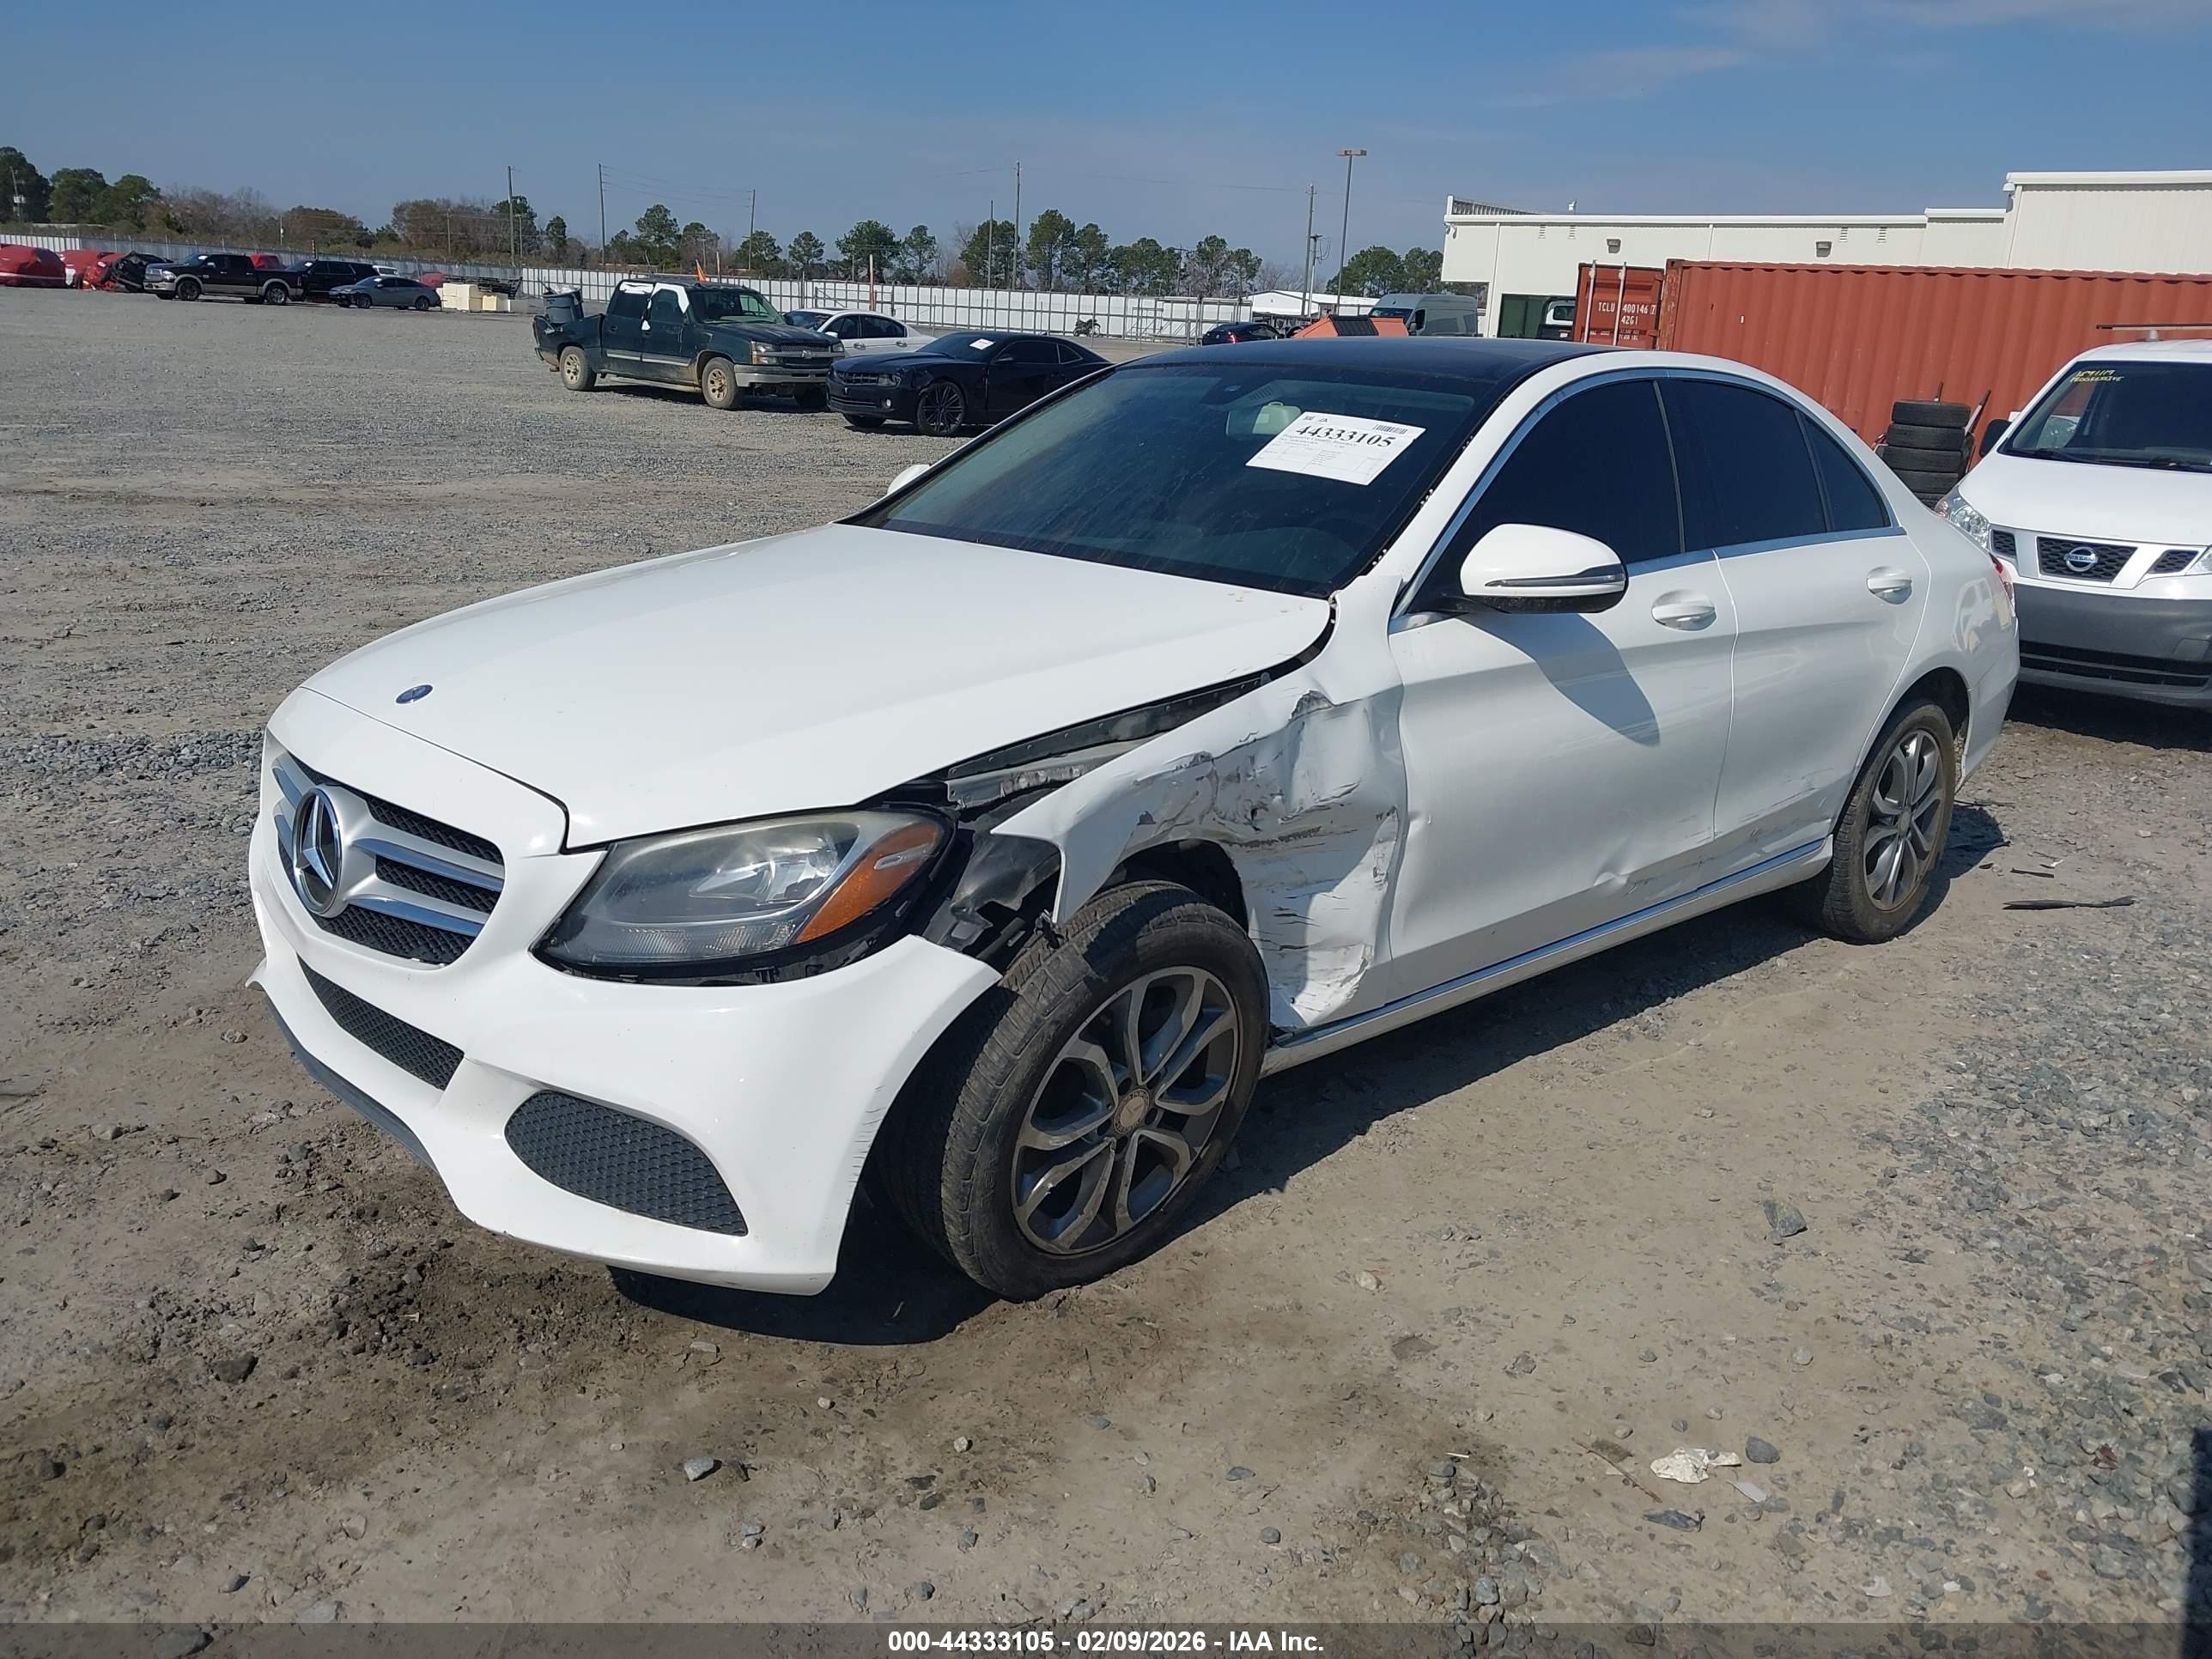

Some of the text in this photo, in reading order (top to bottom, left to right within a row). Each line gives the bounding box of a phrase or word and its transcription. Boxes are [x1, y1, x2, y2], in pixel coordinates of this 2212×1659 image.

[1598, 301, 1615, 312] TCLU
[1622, 303, 1648, 314] 400146
[1296, 425, 1396, 447] 44333105
[2068, 554, 2094, 562] NISSAN
